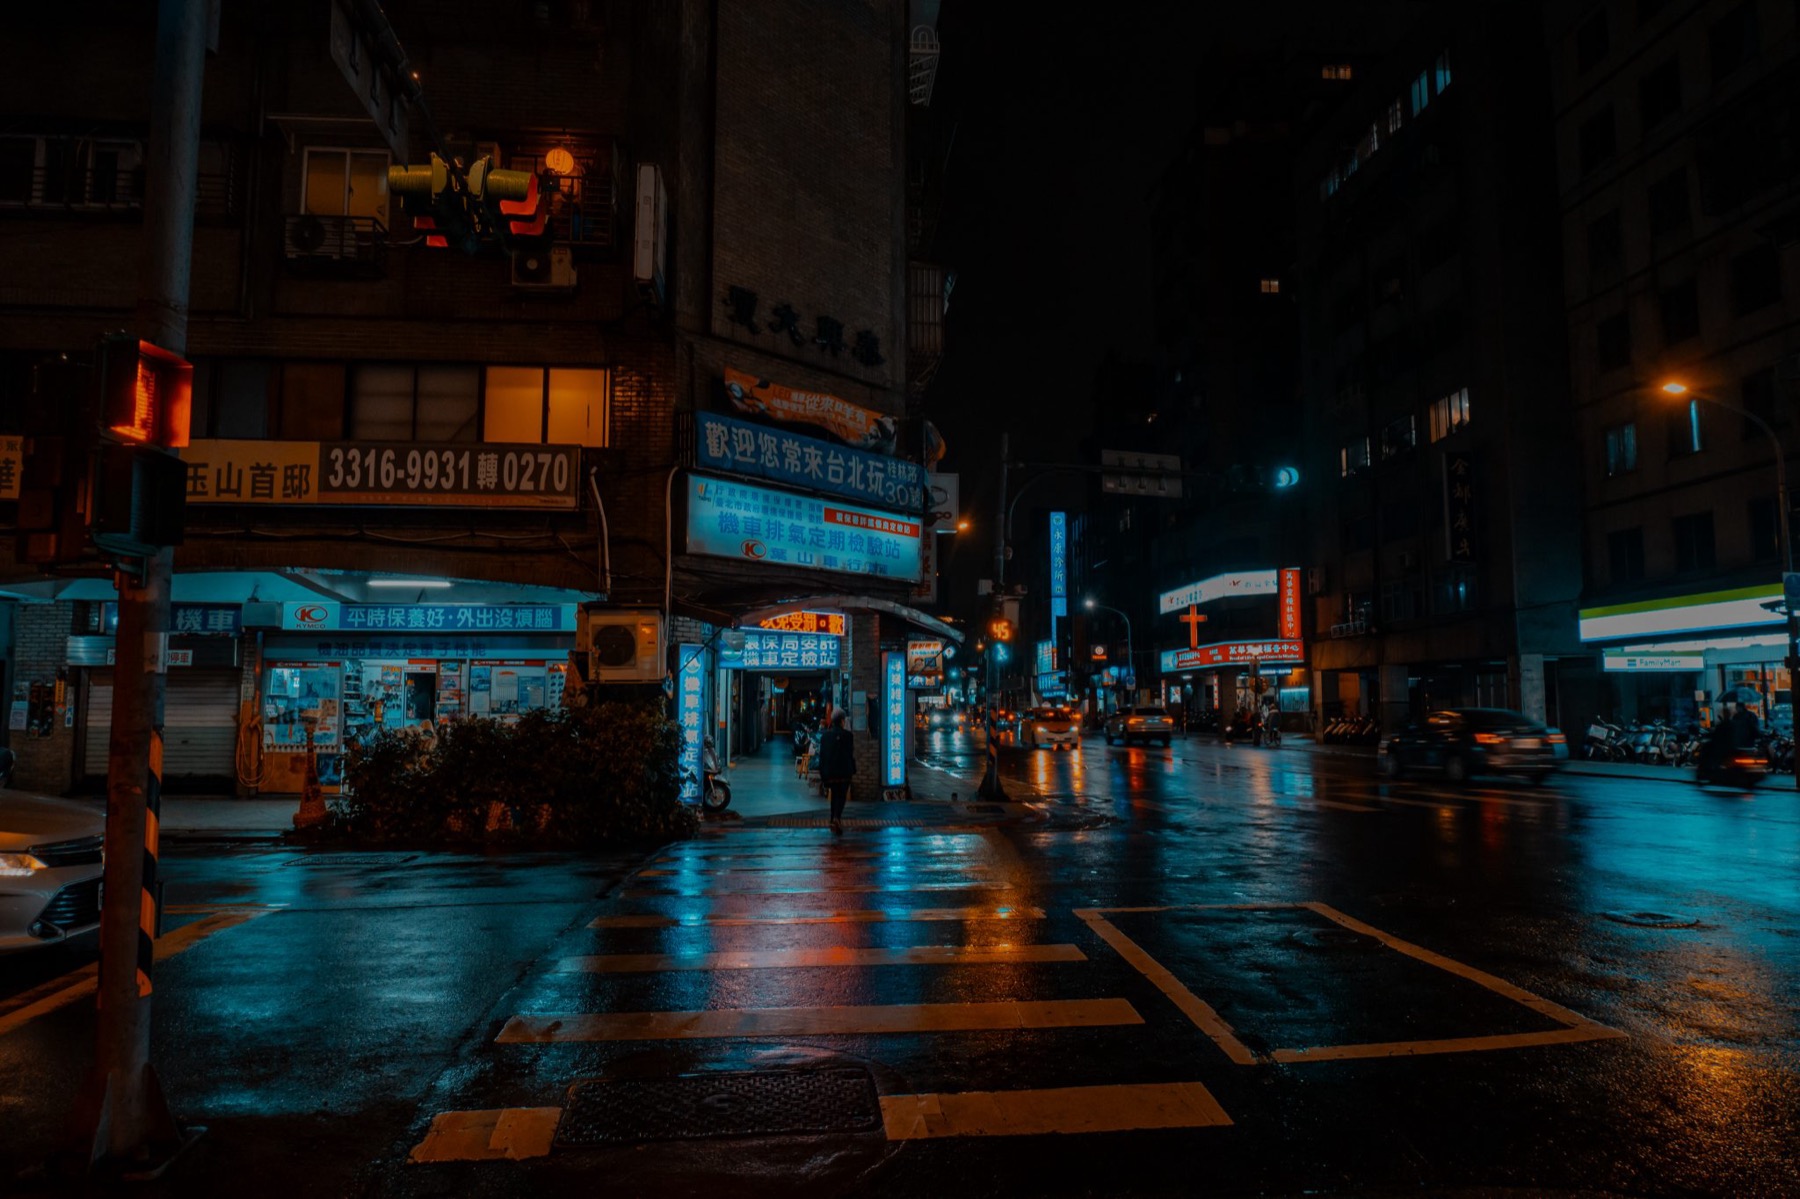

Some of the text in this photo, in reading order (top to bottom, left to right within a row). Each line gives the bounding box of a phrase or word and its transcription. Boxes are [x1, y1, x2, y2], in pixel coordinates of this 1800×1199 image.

[705, 421, 884, 497] 歡迎您常來台北玩
[188, 462, 310, 498] 玉山首邸
[888, 461, 917, 483] 桂林路
[718, 511, 900, 559] 機車排氣定期檢驗站
[176, 608, 236, 631] 機車
[993, 621, 1009, 640] 45
[318, 642, 486, 657] 機油品質決定車子性能
[744, 634, 837, 650] 環保局委託
[743, 651, 837, 666] 機車定檢站
[1640, 659, 1681, 667] FamilyMart
